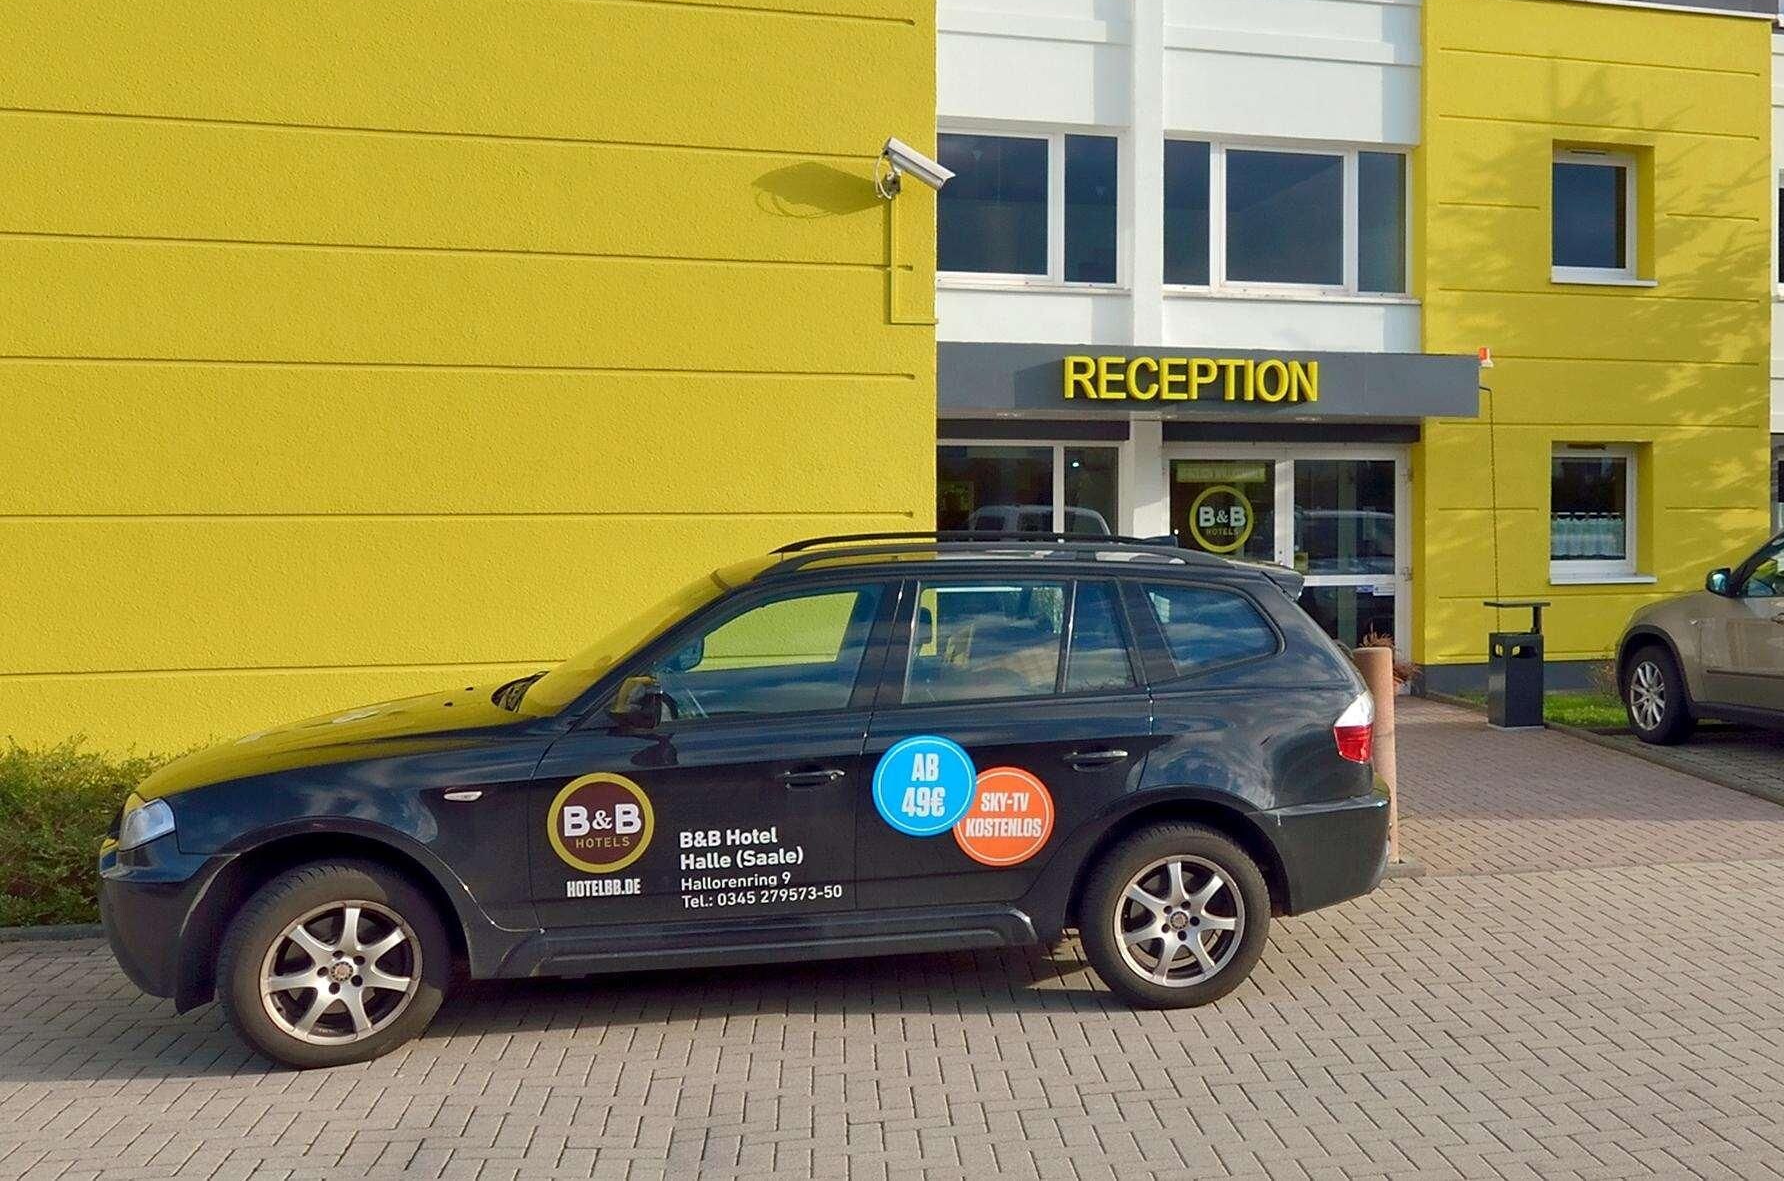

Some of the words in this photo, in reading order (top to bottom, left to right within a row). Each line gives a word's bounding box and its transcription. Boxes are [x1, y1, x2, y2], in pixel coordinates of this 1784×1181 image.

[1063, 355, 1320, 403] RECEPTION
[1199, 506, 1246, 527] B&B
[911, 753, 939, 782] AB
[901, 787, 945, 817] 49€
[980, 792, 1029, 812] SKY-TV
[564, 803, 641, 837] B&B
[965, 817, 1042, 838] KOSTENLOS
[576, 836, 630, 849] HOTELS
[679, 830, 721, 849] B&B
[726, 826, 778, 846] Hotel
[680, 852, 731, 870] Halle
[736, 846, 804, 869] (Saale)
[566, 878, 642, 898] HOTELBB.DE
[681, 873, 778, 892] Hallorenring
[781, 871, 792, 885] 9
[682, 894, 713, 909] Tel.:
[717, 892, 756, 907] 0345
[760, 885, 843, 904] 279573-50
